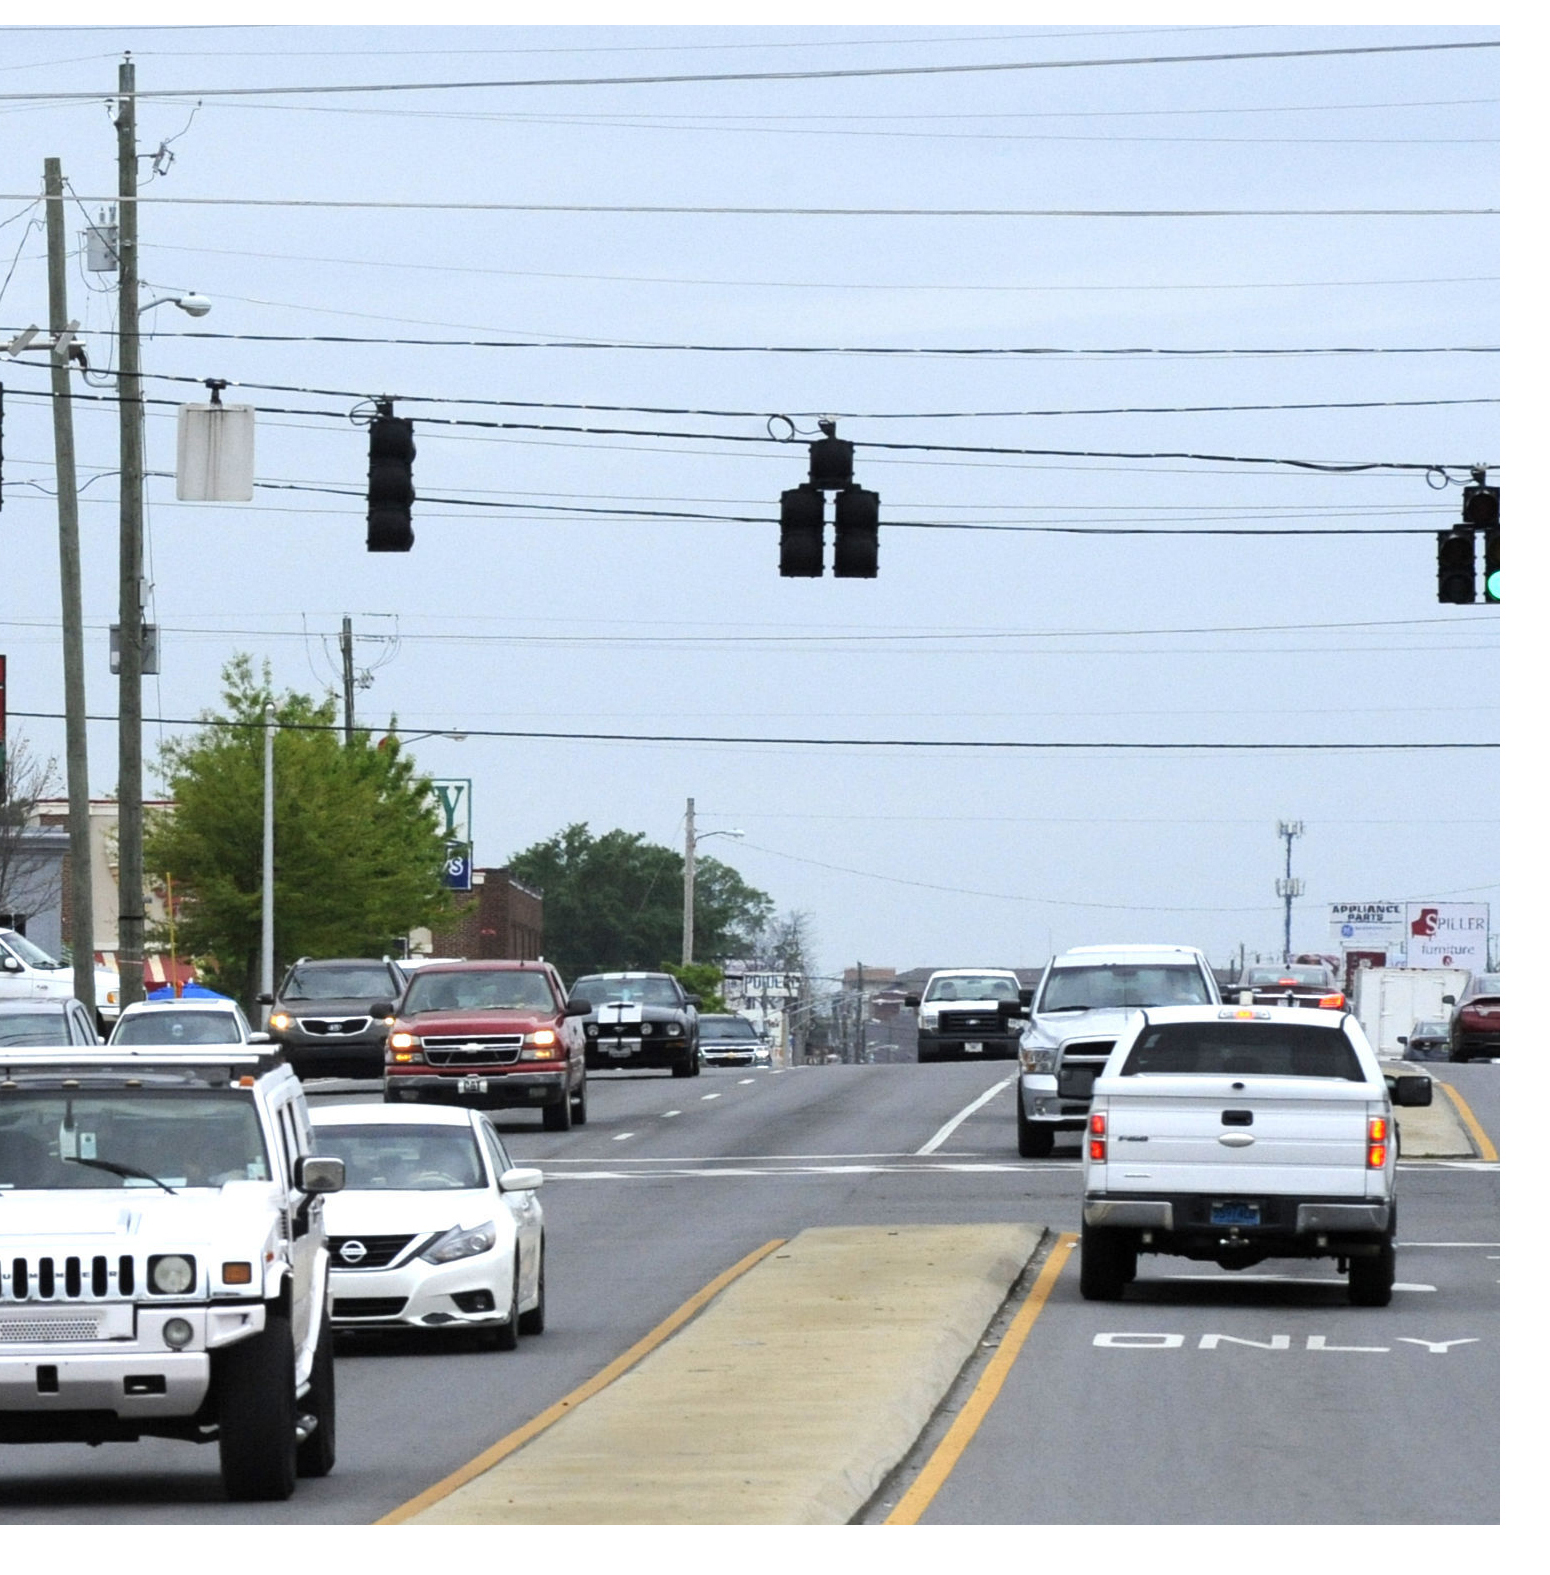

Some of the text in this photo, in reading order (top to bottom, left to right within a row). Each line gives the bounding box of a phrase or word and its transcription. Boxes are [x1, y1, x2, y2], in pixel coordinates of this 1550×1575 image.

[1332, 905, 1400, 914] APPLIANCE
[1348, 913, 1384, 922] PARTS
[1422, 943, 1475, 955] furniture
[1093, 1332, 1480, 1353] ONLY
